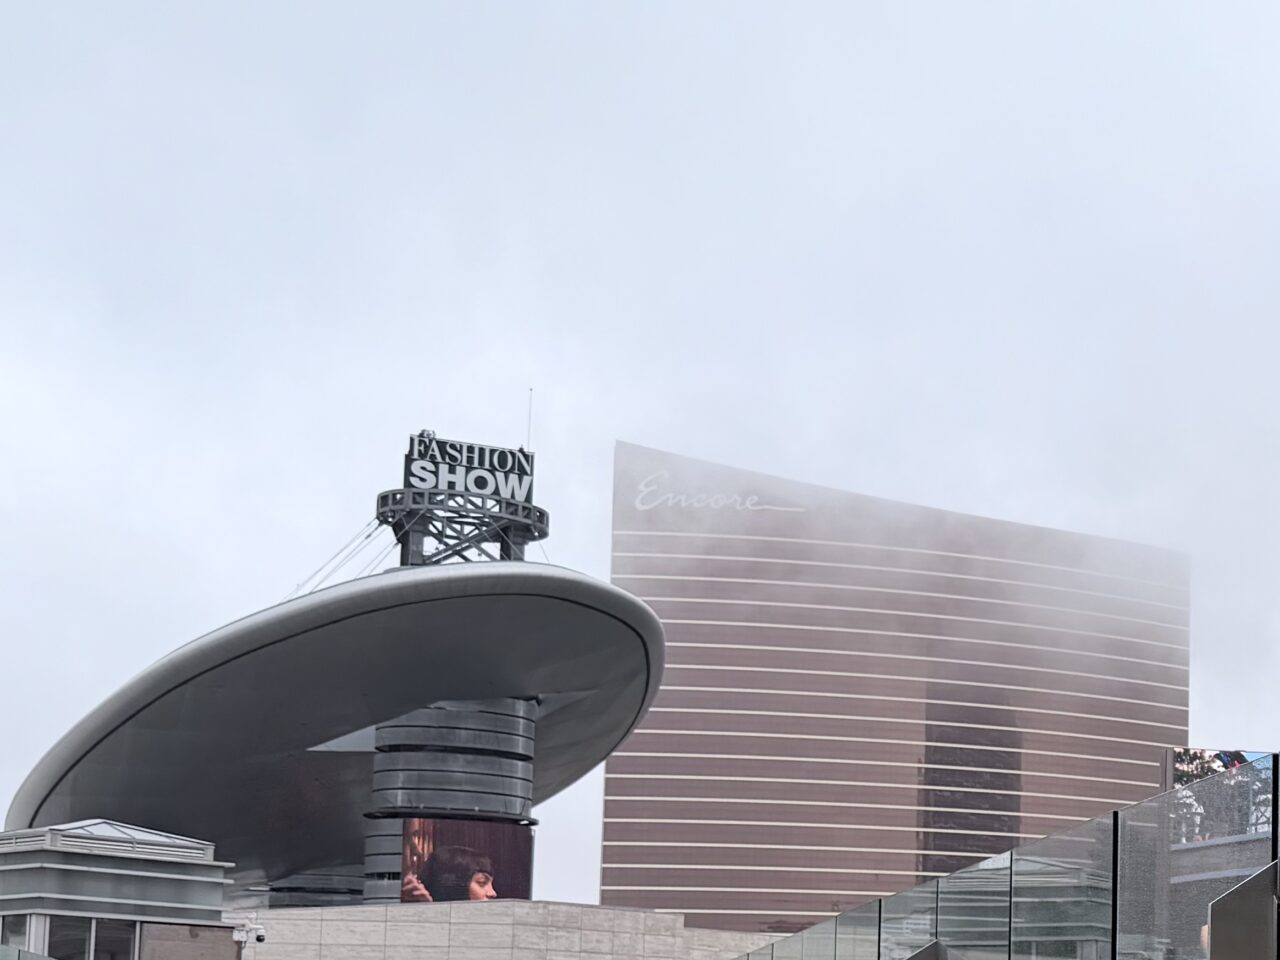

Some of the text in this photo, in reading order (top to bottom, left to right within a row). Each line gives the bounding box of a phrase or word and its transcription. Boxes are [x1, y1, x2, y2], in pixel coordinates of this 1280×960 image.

[410, 435, 534, 476] FASHION
[409, 460, 533, 502] SHOW
[634, 471, 805, 511] Encore
